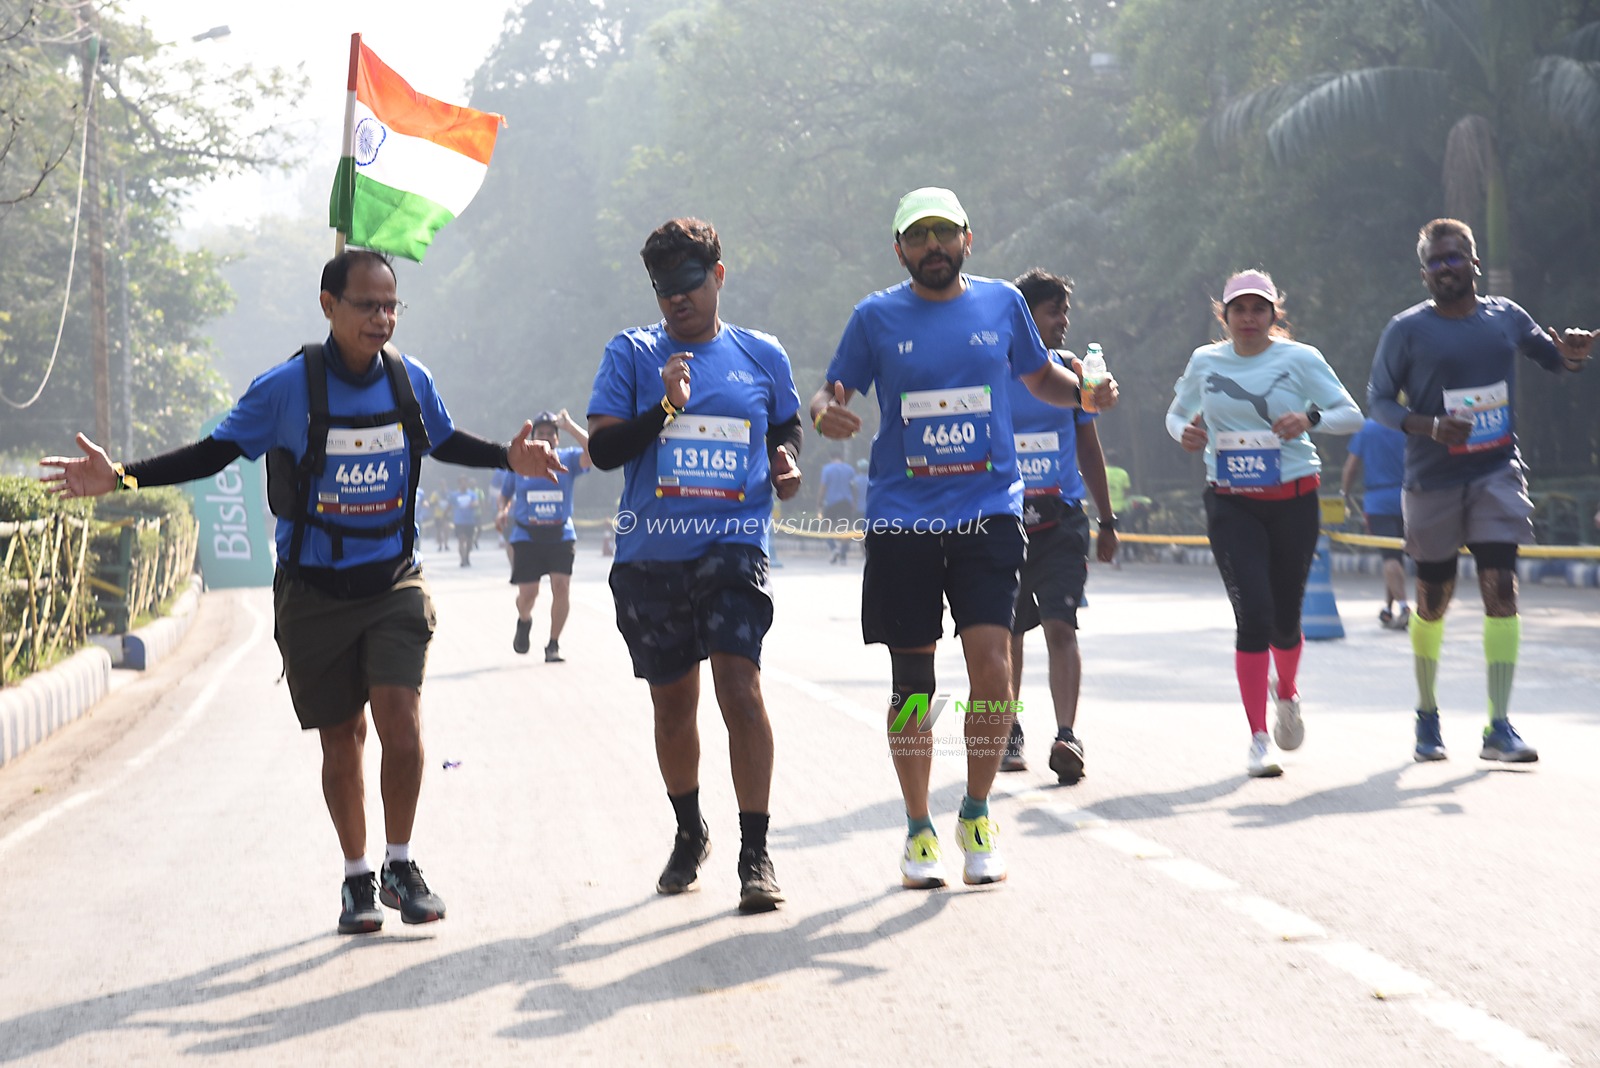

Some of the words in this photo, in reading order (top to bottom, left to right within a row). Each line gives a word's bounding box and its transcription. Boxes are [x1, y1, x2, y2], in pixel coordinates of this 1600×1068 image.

[922, 421, 976, 446] 4660
[673, 447, 737, 471] 13165
[1227, 456, 1266, 472] 5374
[336, 461, 389, 485] 4664
[341, 484, 368, 494] PRAKASH
